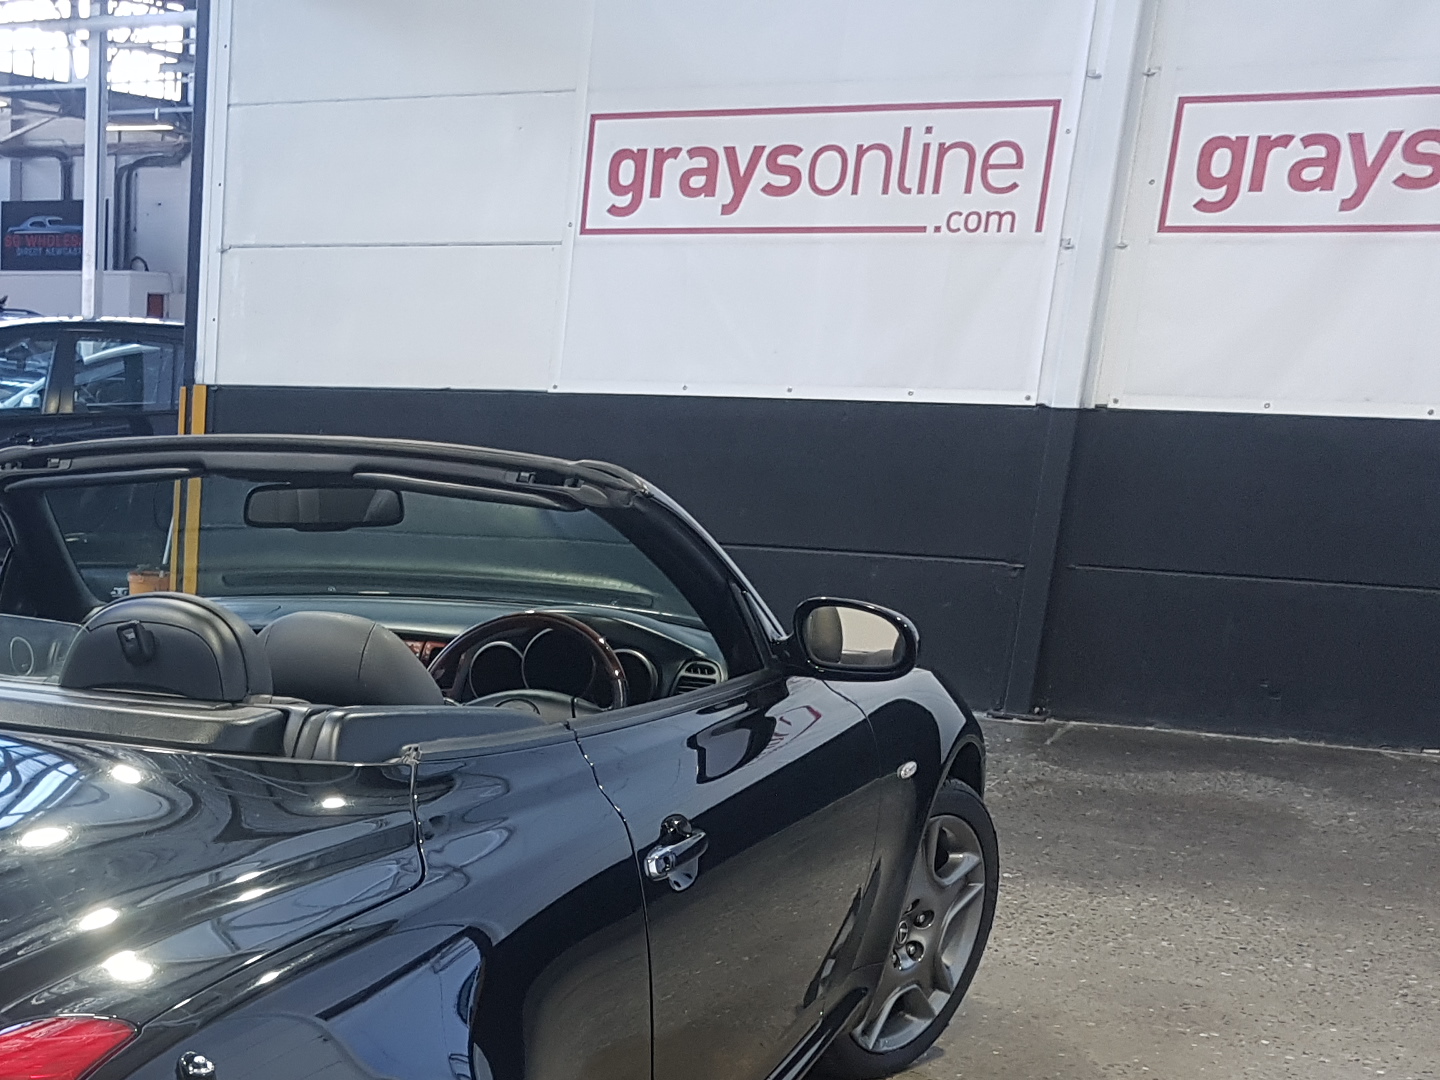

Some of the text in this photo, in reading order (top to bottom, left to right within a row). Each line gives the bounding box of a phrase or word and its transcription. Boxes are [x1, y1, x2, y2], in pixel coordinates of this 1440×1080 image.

[606, 126, 1025, 218] graysonline
[933, 209, 1017, 234] .com
[25, 233, 83, 248] WHOLES
